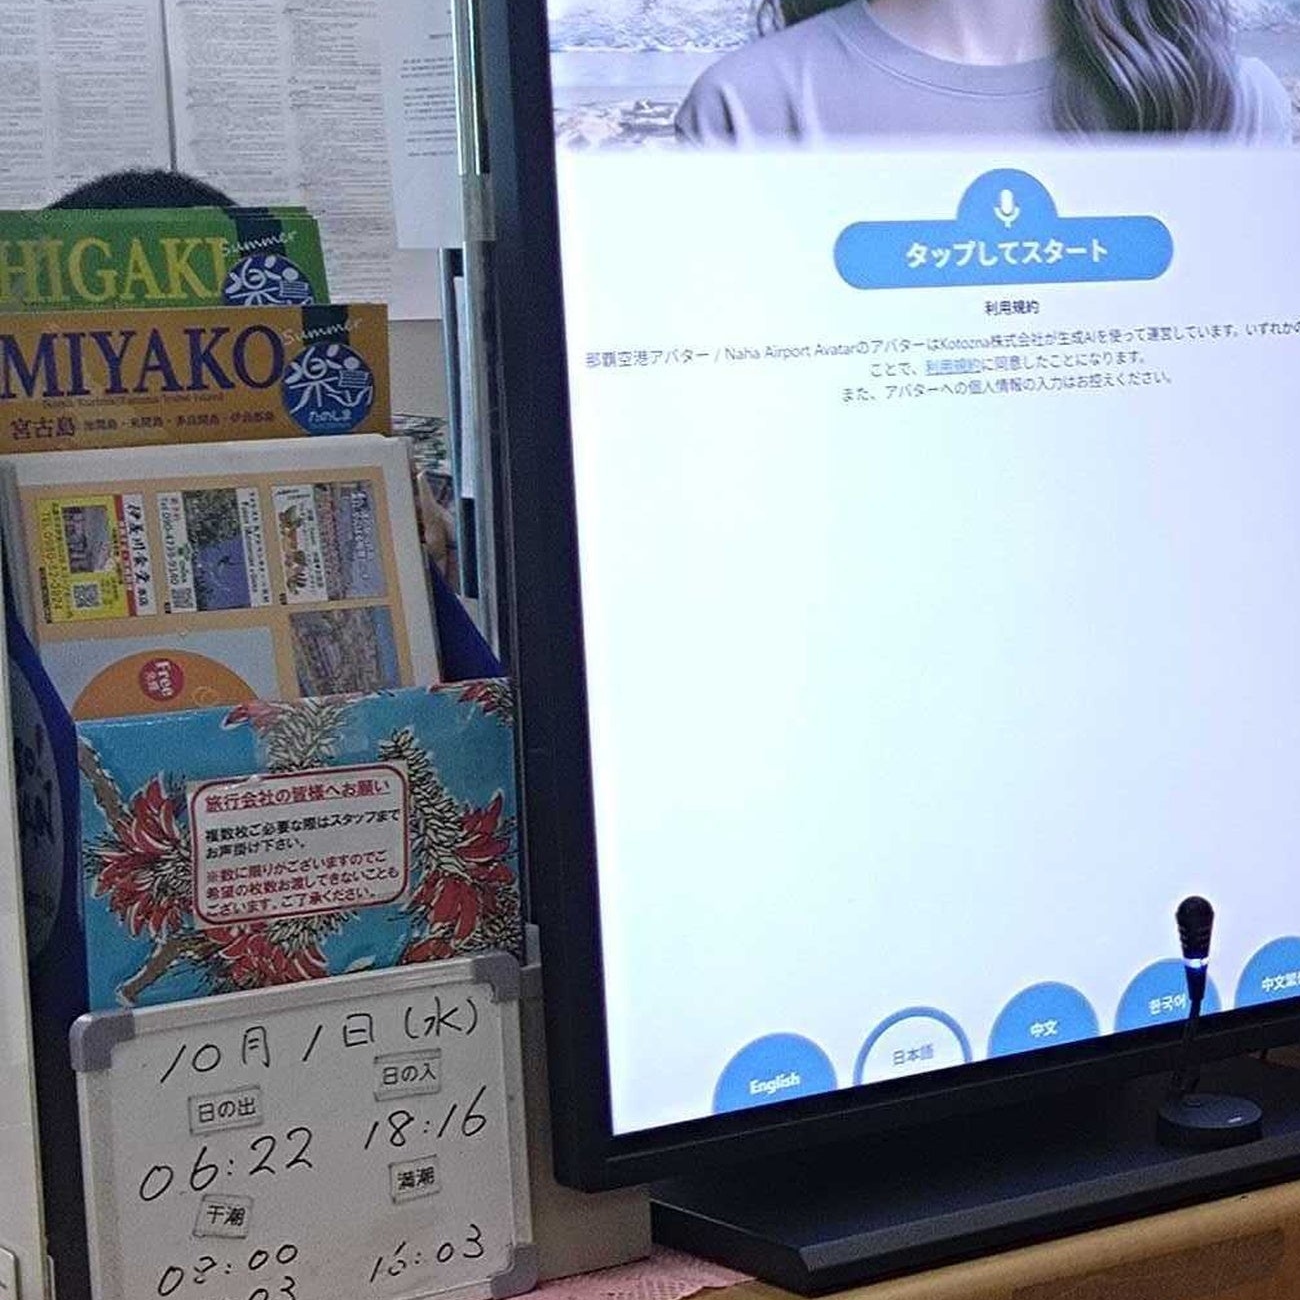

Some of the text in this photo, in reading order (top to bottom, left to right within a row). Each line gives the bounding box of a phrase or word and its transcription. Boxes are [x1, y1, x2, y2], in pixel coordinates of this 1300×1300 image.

[905, 237, 1109, 269] タップしてスタート
[984, 300, 1040, 316] 利用規約
[284, 317, 363, 345] Summer
[2, 324, 284, 399] MIYAKO
[724, 346, 760, 362] Naha
[764, 345, 812, 362] Airport
[11, 416, 76, 440] 宮古島
[155, 660, 175, 697] Free
[205, 780, 391, 813] 旅行会社の皆様へお願い
[205, 809, 401, 843] 複数枚ご必要な際はスタッフまで
[205, 838, 305, 860] お声掛け下さい。
[206, 866, 400, 899] 希望の枚数お渡しできないことも
[206, 887, 376, 917] ございます。ご了承ください。
[1148, 992, 1187, 1016] 한국어
[1029, 1018, 1059, 1038] 中文
[892, 1043, 935, 1067] 日本語
[382, 1061, 437, 1087] 日の入
[749, 1072, 801, 1096] English
[198, 1096, 257, 1123] 日の出
[364, 1086, 487, 1150] 18:16
[140, 1127, 314, 1201] 06:22
[397, 1166, 436, 1191] 満潮
[206, 1204, 246, 1227] 干潮
